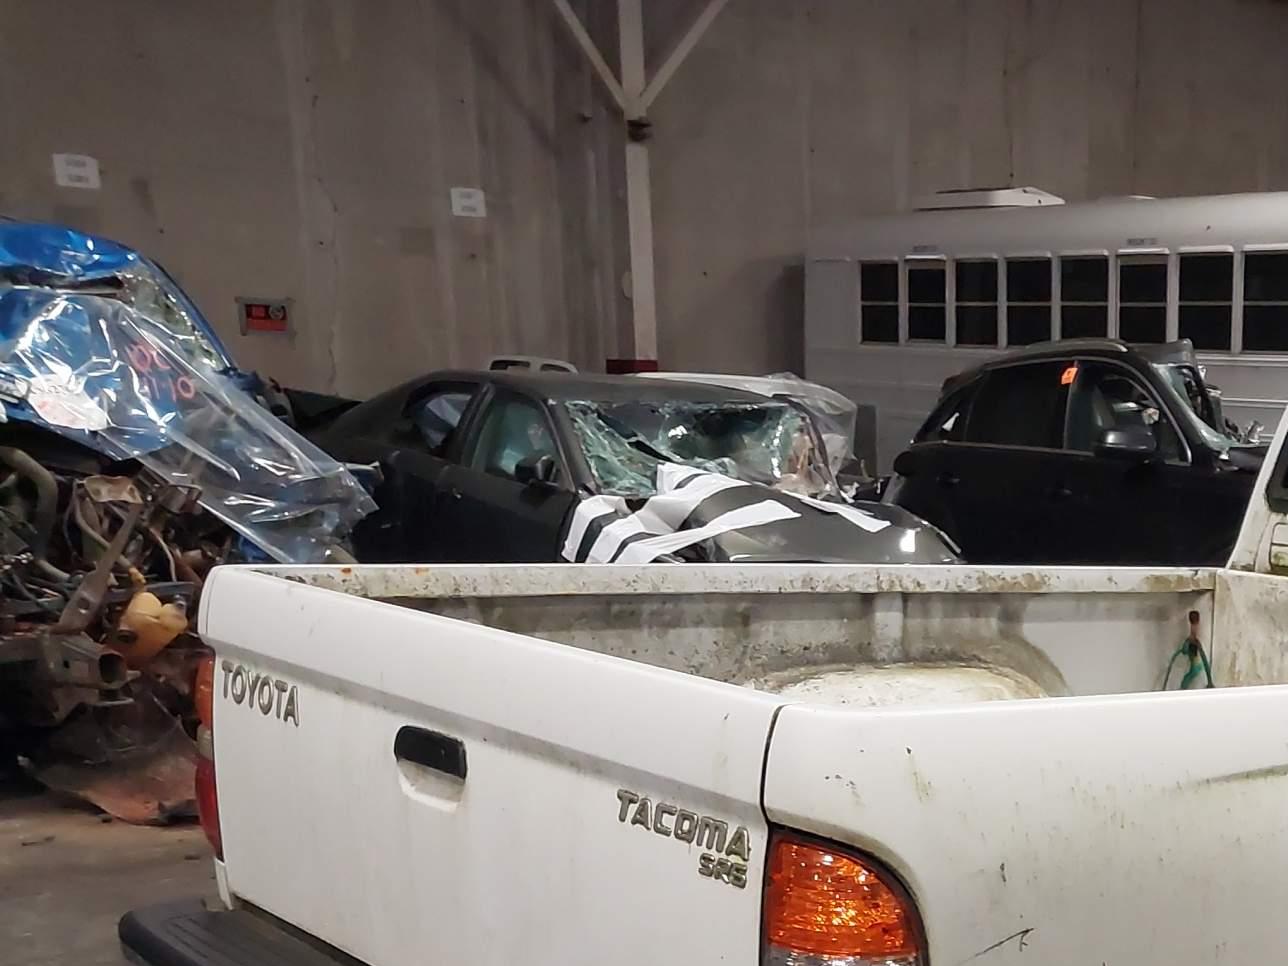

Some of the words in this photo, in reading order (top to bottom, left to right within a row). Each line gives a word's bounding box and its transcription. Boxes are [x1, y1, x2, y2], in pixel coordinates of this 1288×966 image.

[221, 660, 300, 728] TOYOTA
[616, 788, 752, 862] TACOMA
[697, 852, 748, 889] SR5
